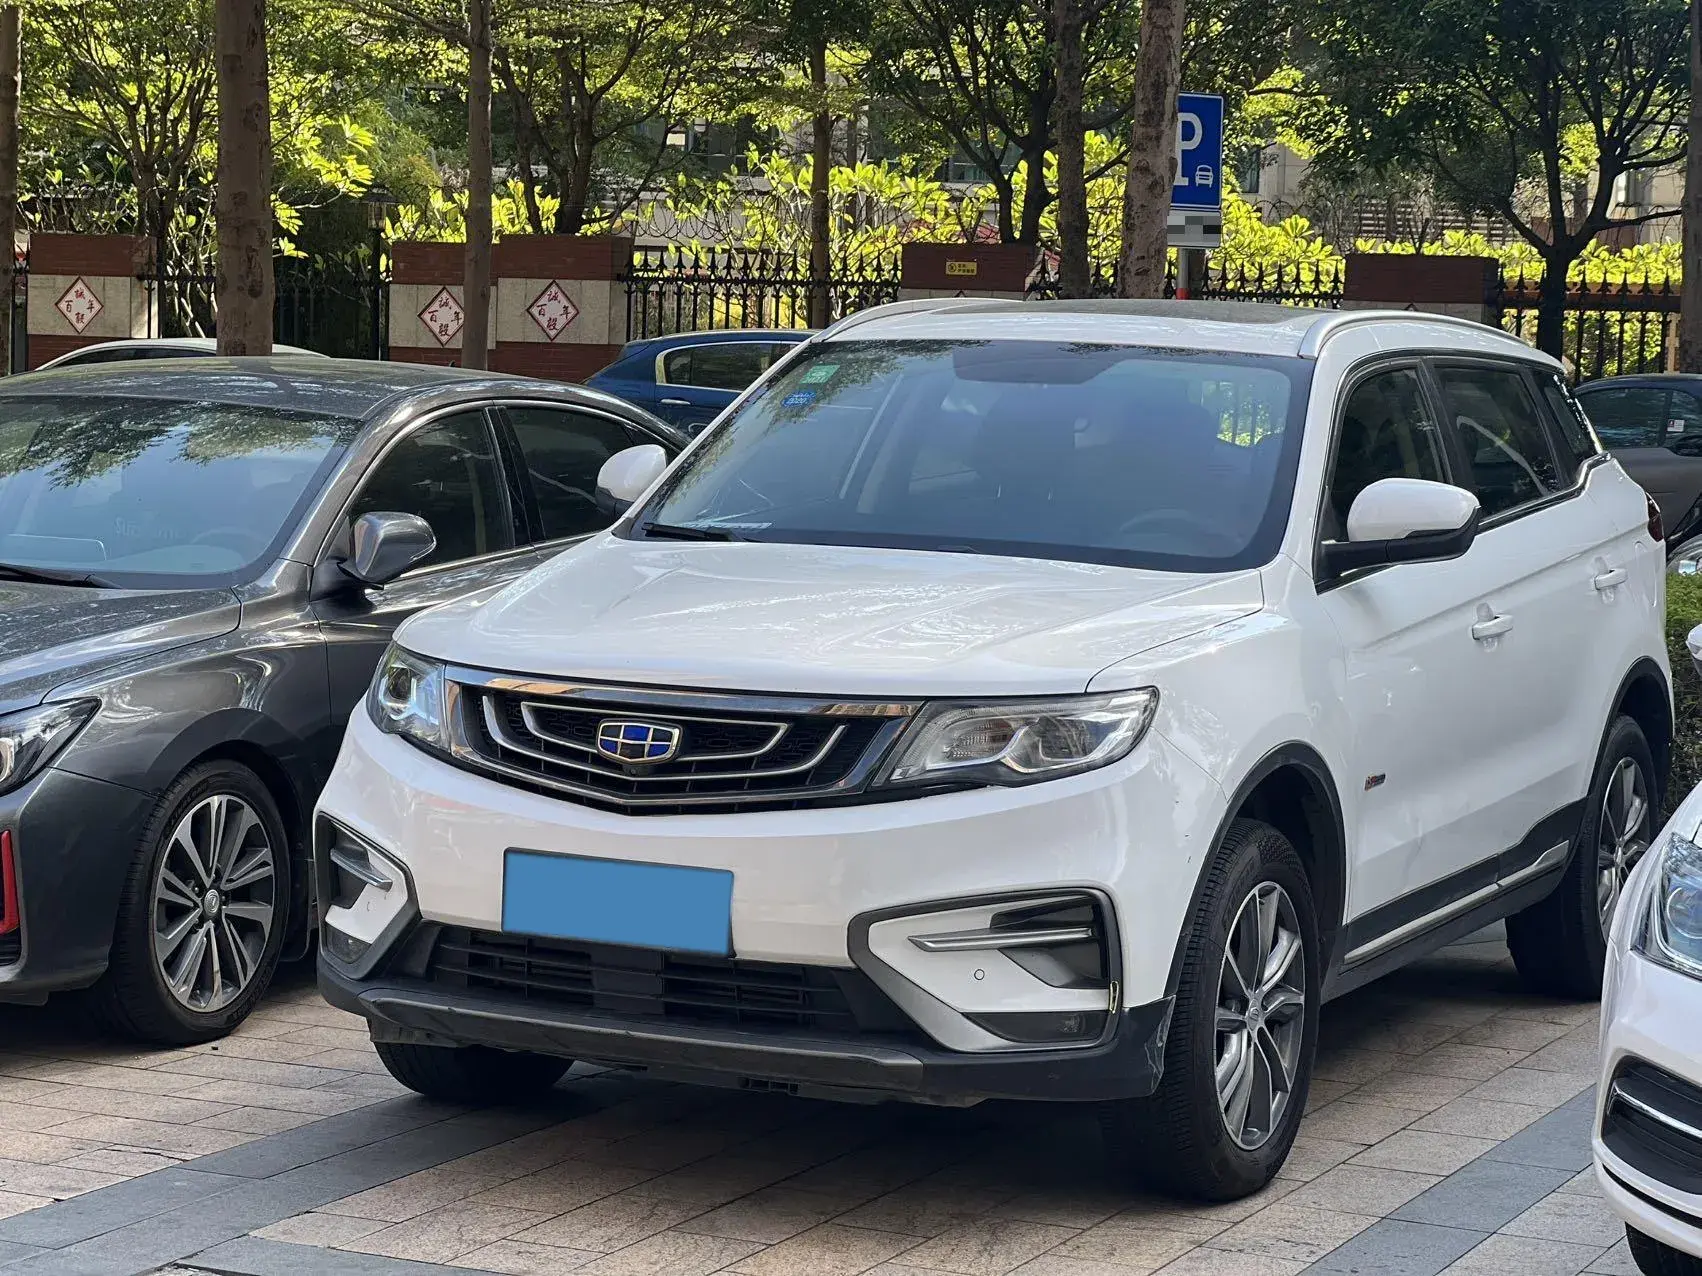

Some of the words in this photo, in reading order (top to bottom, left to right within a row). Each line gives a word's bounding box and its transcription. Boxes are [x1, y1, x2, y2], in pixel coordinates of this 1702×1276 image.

[1173, 112, 1203, 186] P
[427, 309, 439, 323] 百
[450, 310, 462, 326] 年
[536, 303, 547, 317] 百
[559, 304, 571, 320] 年
